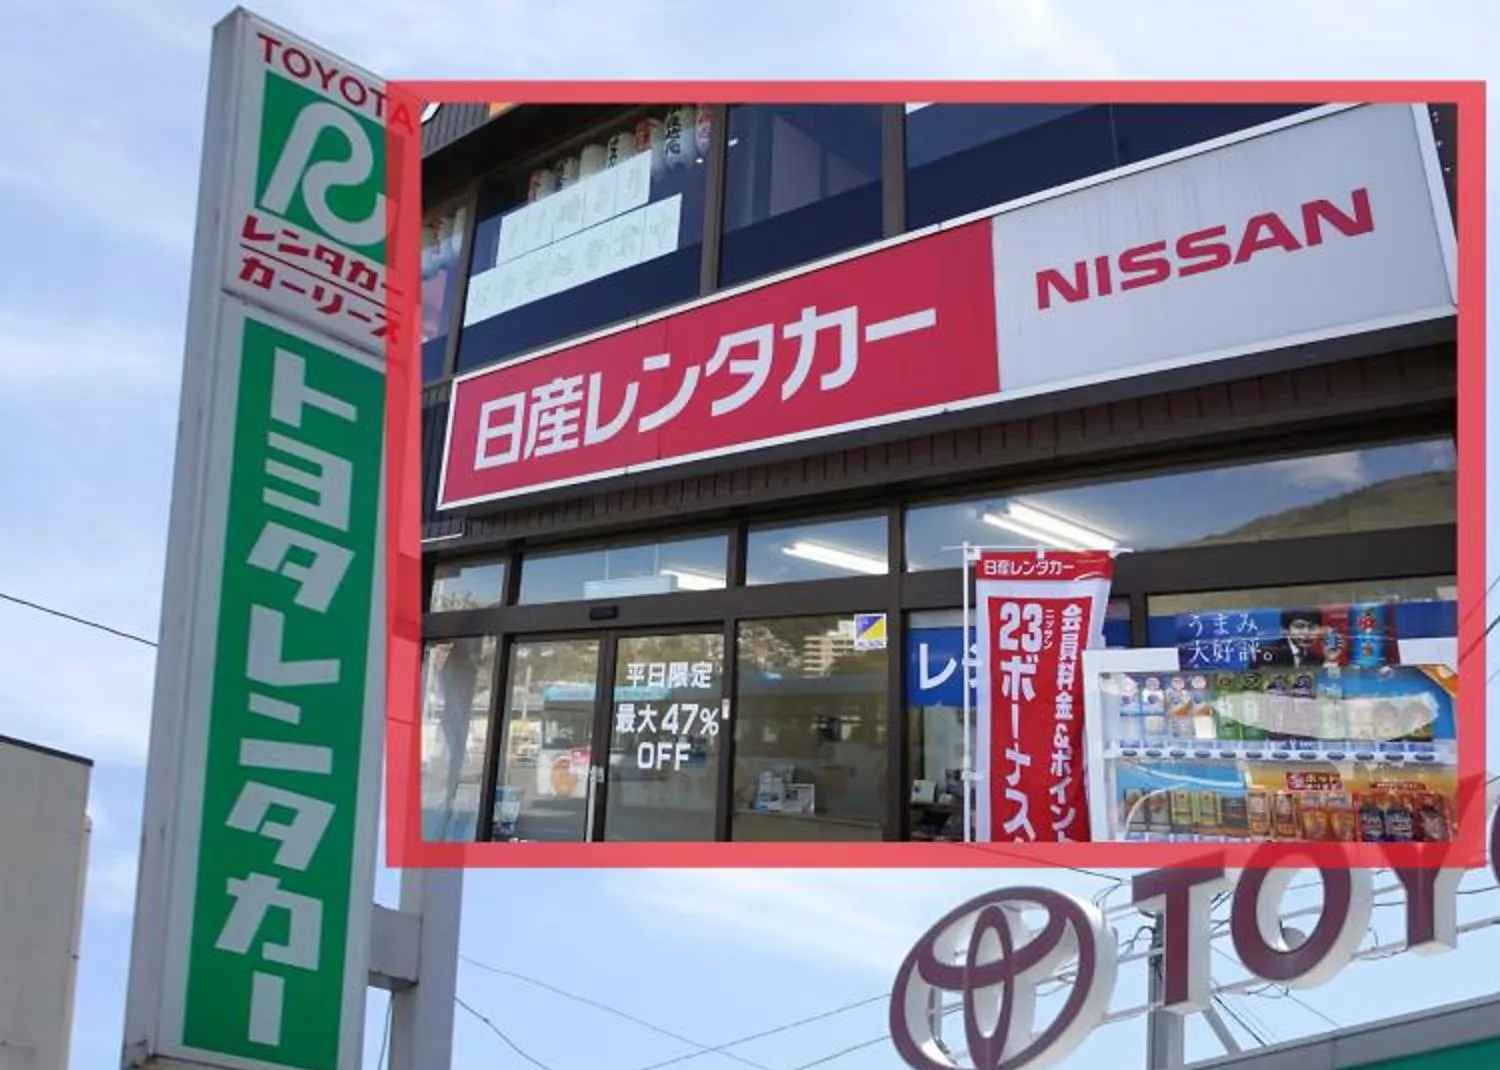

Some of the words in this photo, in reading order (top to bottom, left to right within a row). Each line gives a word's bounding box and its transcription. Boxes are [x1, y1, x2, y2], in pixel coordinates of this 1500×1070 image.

[257, 33, 414, 135] TOYOTA
[242, 215, 403, 297] レンタカー
[1035, 187, 1375, 310] NISSAN
[239, 257, 400, 343] カーリース
[473, 305, 937, 471] 日産レンタカー
[984, 559, 1075, 577] 日産レンタカー
[213, 346, 357, 1047] トヨタレンタカー
[637, 741, 691, 772] OFF
